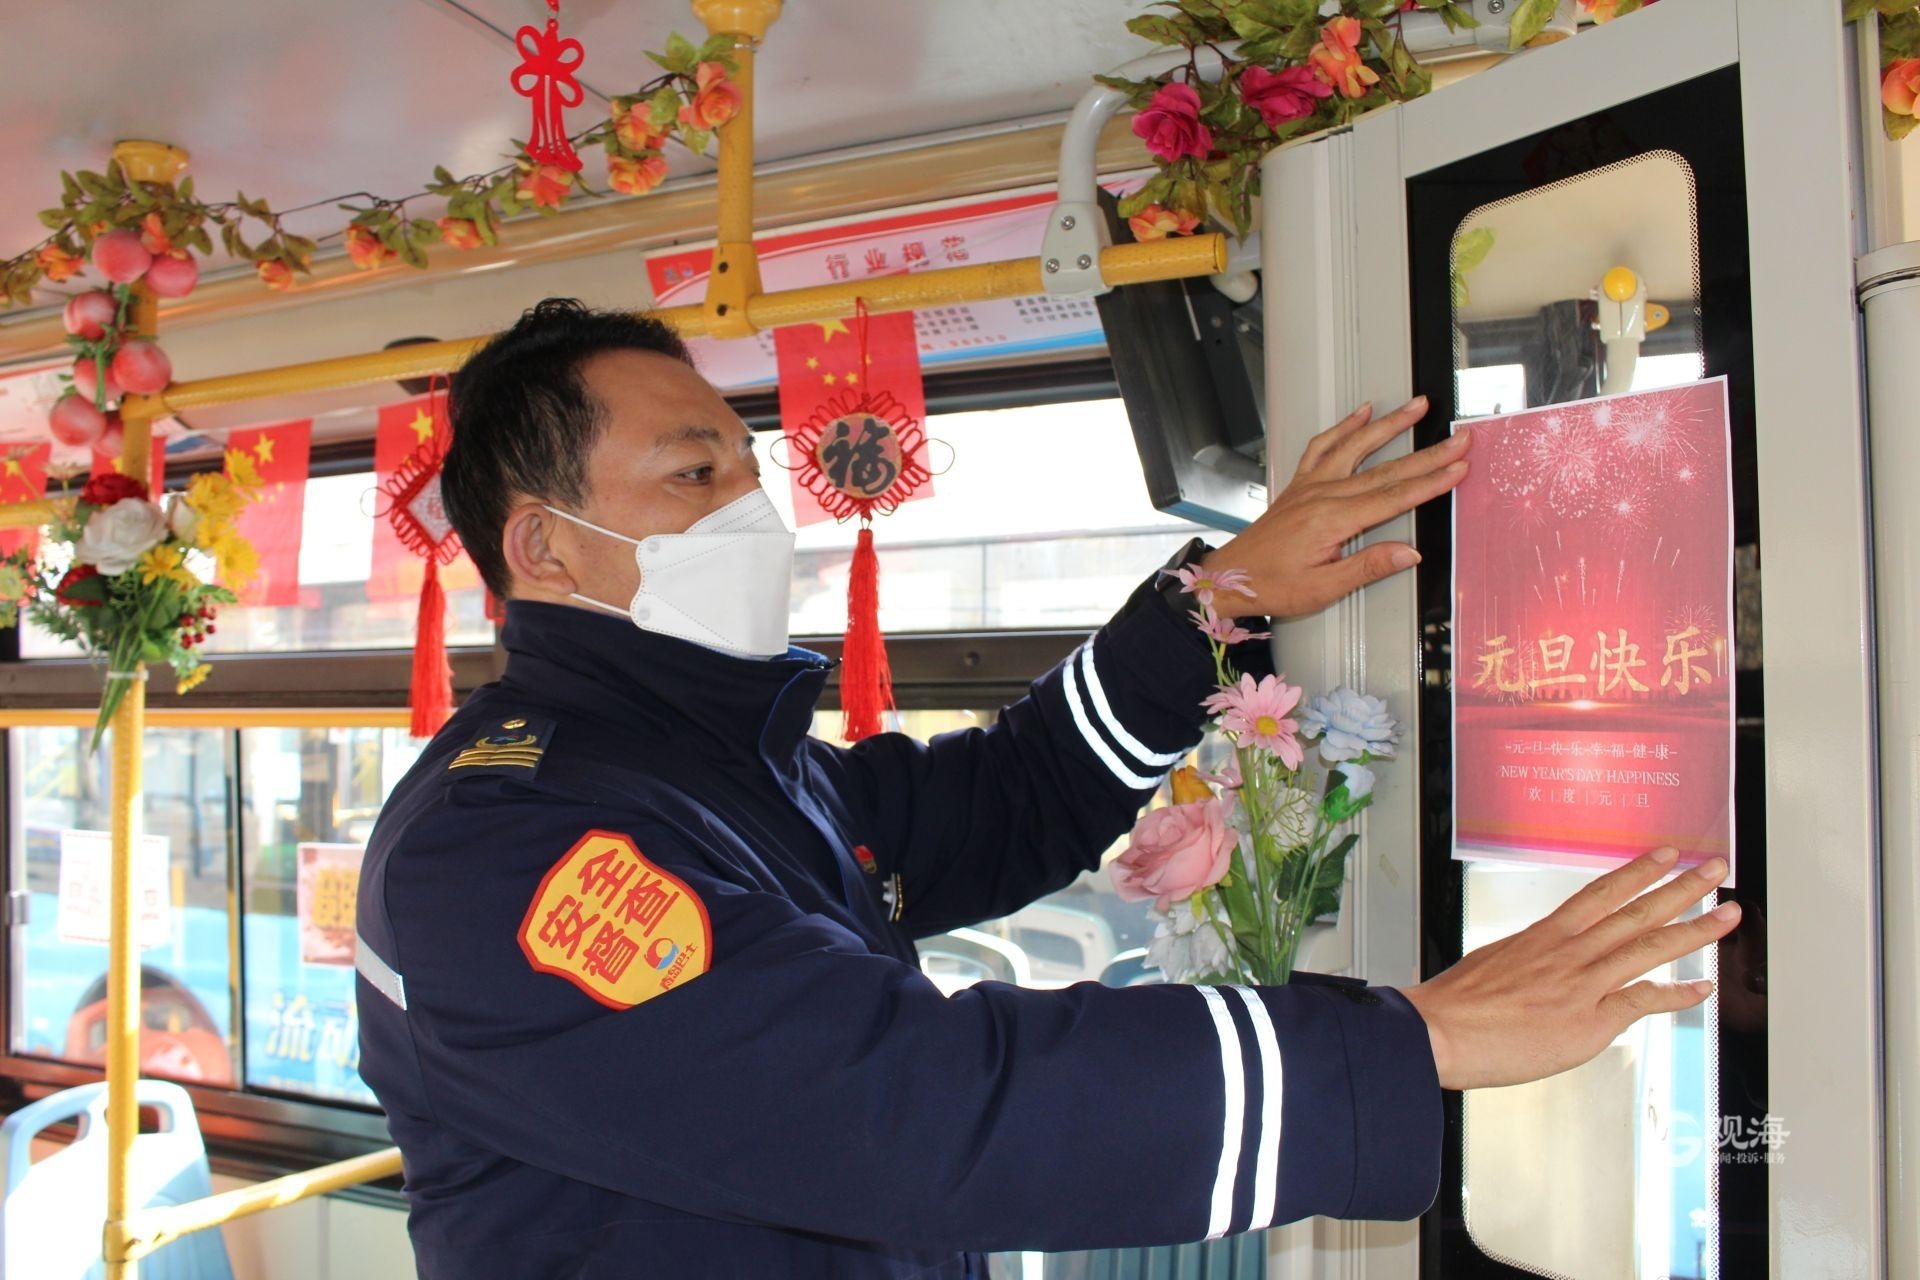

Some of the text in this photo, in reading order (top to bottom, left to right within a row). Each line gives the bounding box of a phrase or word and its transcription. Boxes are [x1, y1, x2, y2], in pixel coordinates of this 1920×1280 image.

[822, 417, 896, 494] 福
[1472, 625, 1713, 696] 元旦快乐
[1501, 765, 1529, 779] NEW
[1606, 769, 1680, 786] HAPPINESS
[538, 848, 638, 960] 安全
[582, 871, 680, 985] 督查
